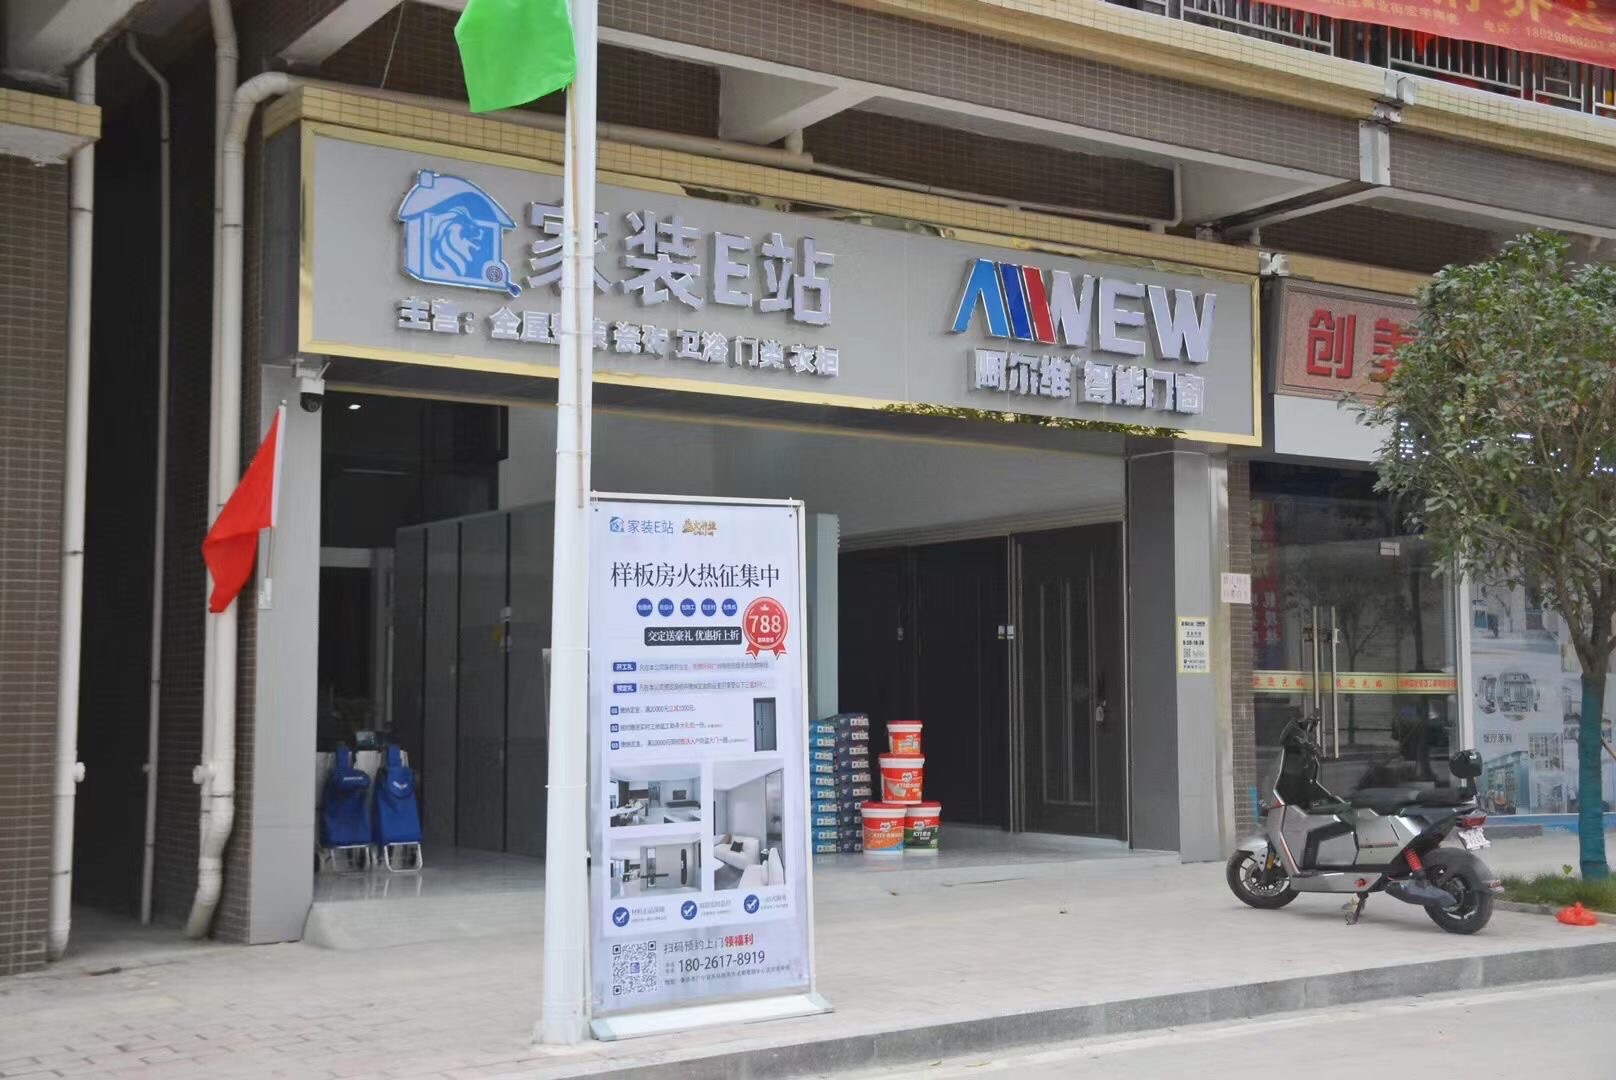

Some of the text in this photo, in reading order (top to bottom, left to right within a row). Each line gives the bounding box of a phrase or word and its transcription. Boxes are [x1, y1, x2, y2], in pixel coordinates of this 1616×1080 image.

[524, 200, 835, 326] 家装E站
[613, 321, 668, 355] 瓷砖
[675, 329, 729, 363] 卫浴
[733, 336, 785, 370] 门类
[789, 343, 840, 377] 衣柜
[1084, 360, 1205, 415] 智能门窗
[628, 519, 674, 535] 家装E站
[610, 562, 780, 589] 样板房火热征集中
[648, 629, 740, 642] 交定送豪礼 优惠折上折
[749, 615, 782, 634] 788
[663, 933, 754, 954] 扫码预约上门领福利
[678, 950, 766, 973] 180-2617-8919
